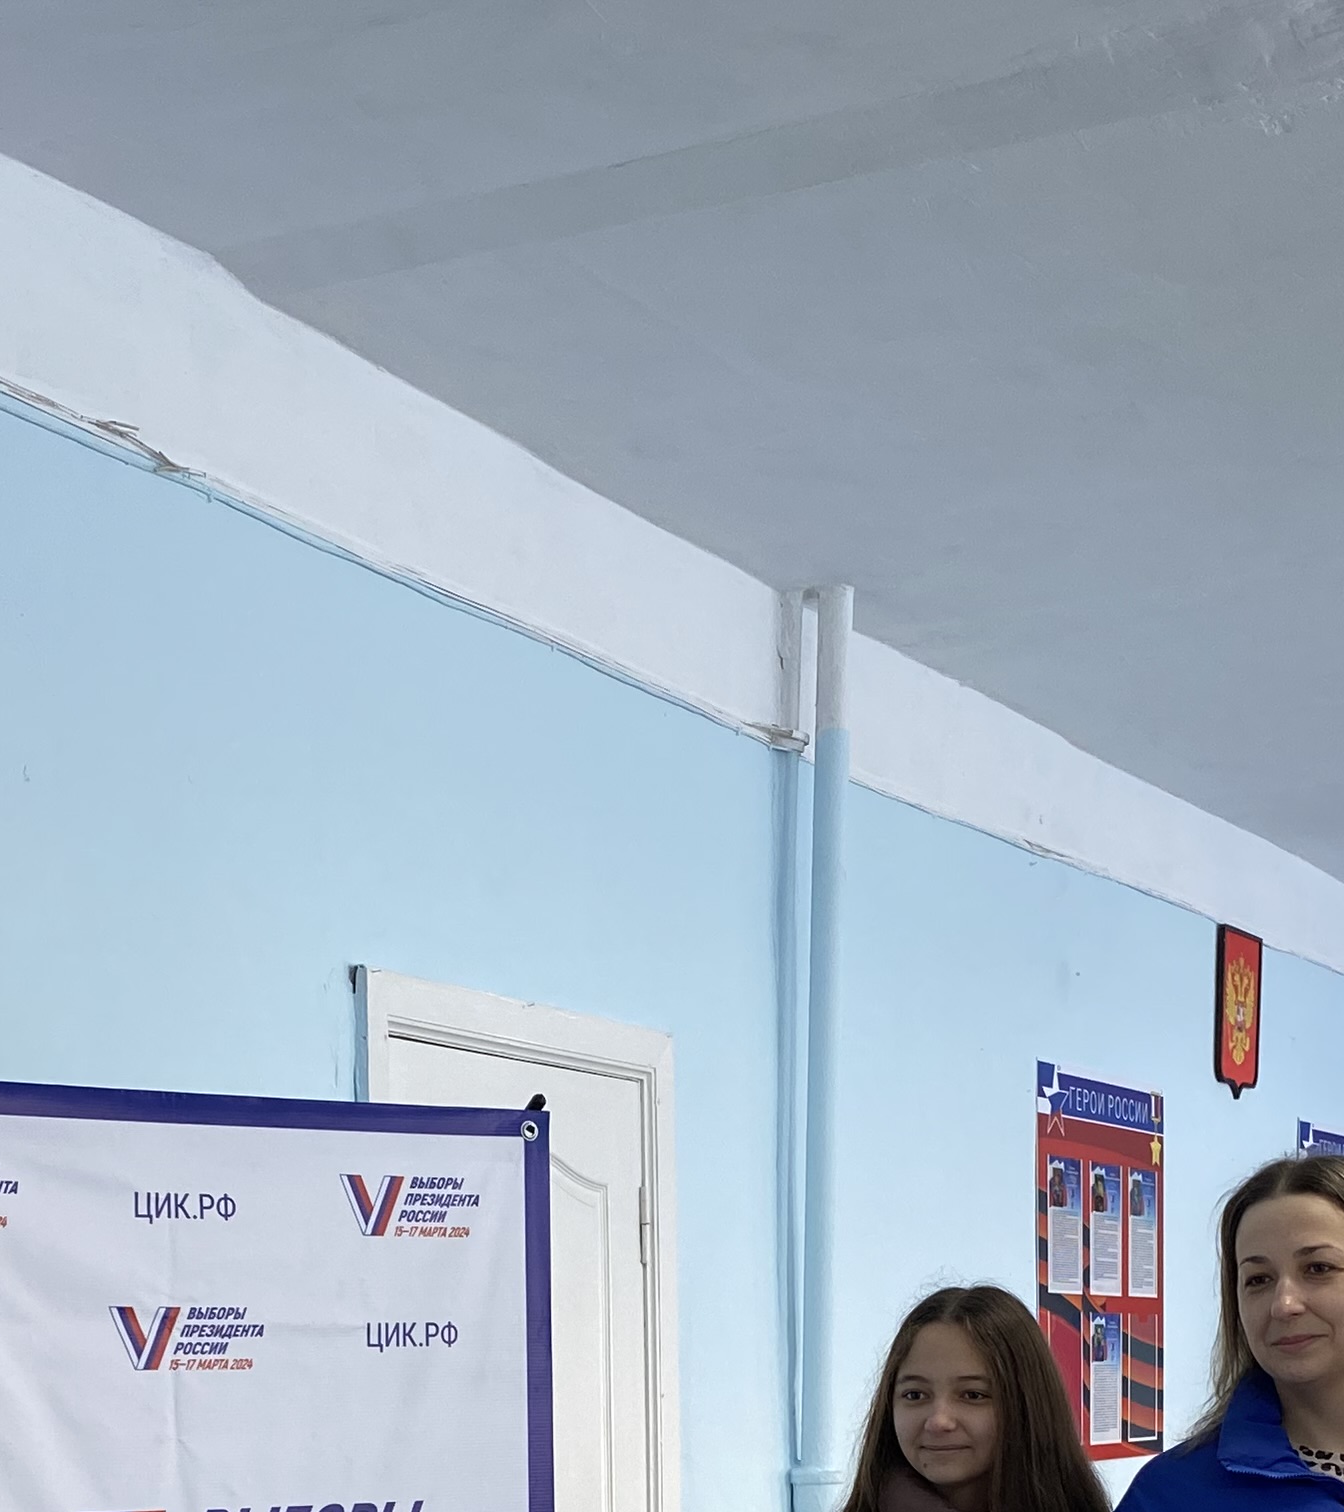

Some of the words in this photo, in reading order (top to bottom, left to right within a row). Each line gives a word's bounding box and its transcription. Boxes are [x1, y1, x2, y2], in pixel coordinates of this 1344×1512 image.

[1068, 1086, 1105, 1115] ГЕРОИ
[1107, 1095, 1149, 1124] РОССИИ
[410, 1177, 464, 1190] ВЫБОРЫ
[134, 1191, 236, 1224] ЦИК.РФ
[404, 1193, 480, 1208] ПРЕЗИДЕНТА
[398, 1211, 447, 1223] РОССИИ
[187, 1307, 247, 1320] ВЫБОРЫ
[180, 1324, 264, 1339] ПРЕЗИДЕНТА
[366, 1322, 458, 1352] ЦИК.РФ
[173, 1342, 228, 1355] РОССИИ
